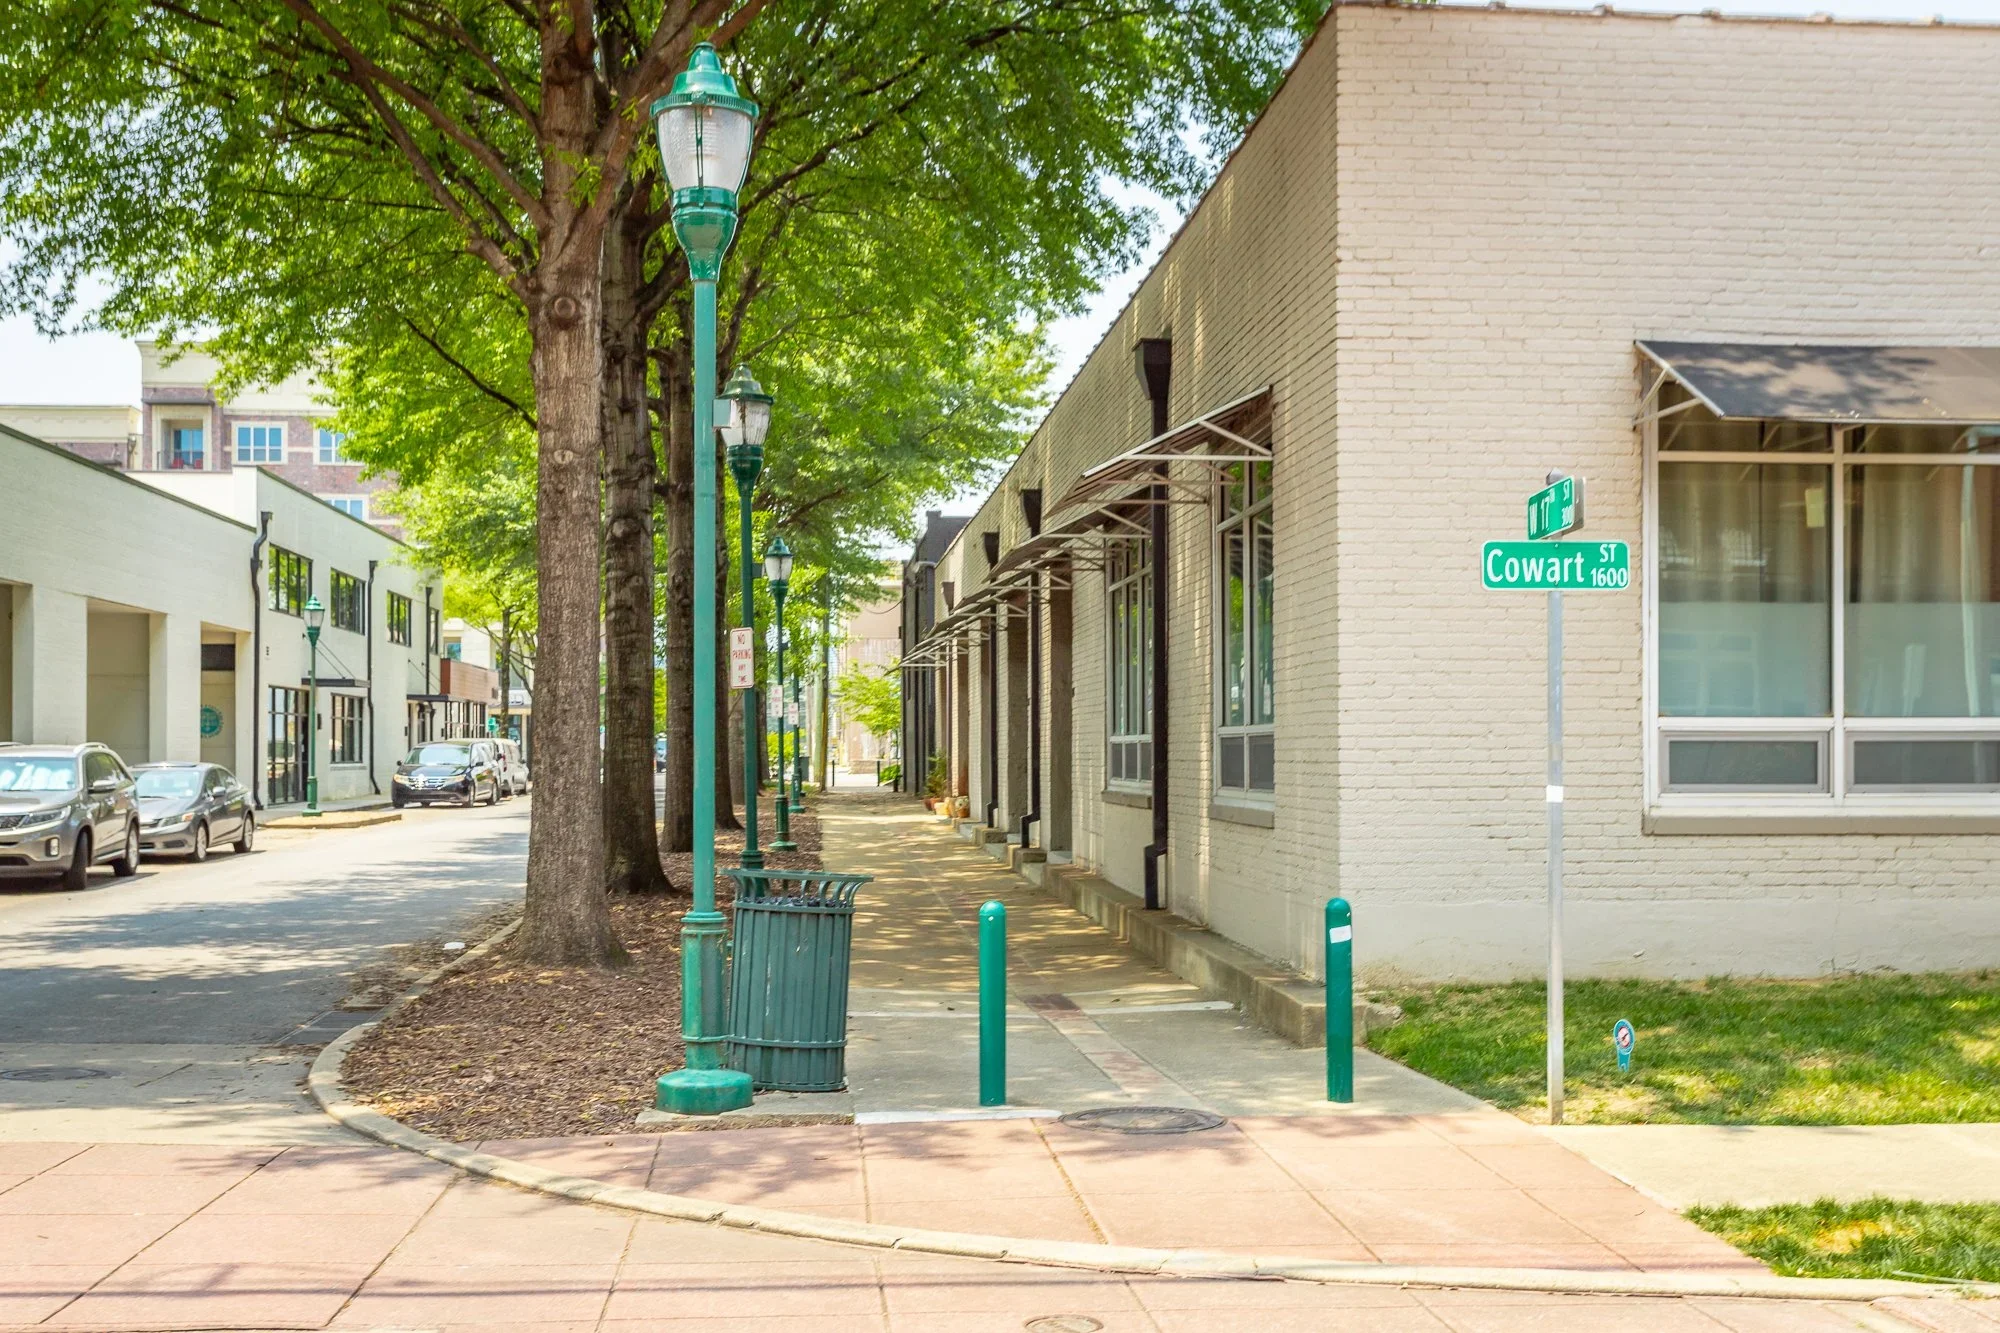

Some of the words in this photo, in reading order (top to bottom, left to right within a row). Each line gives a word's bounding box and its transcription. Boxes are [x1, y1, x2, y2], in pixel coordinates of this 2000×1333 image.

[1529, 502, 1538, 536] W
[1563, 479, 1571, 502] ST
[1486, 548, 1585, 583] Cowart
[1599, 543, 1617, 563] ST
[1590, 567, 1628, 588] 1600
